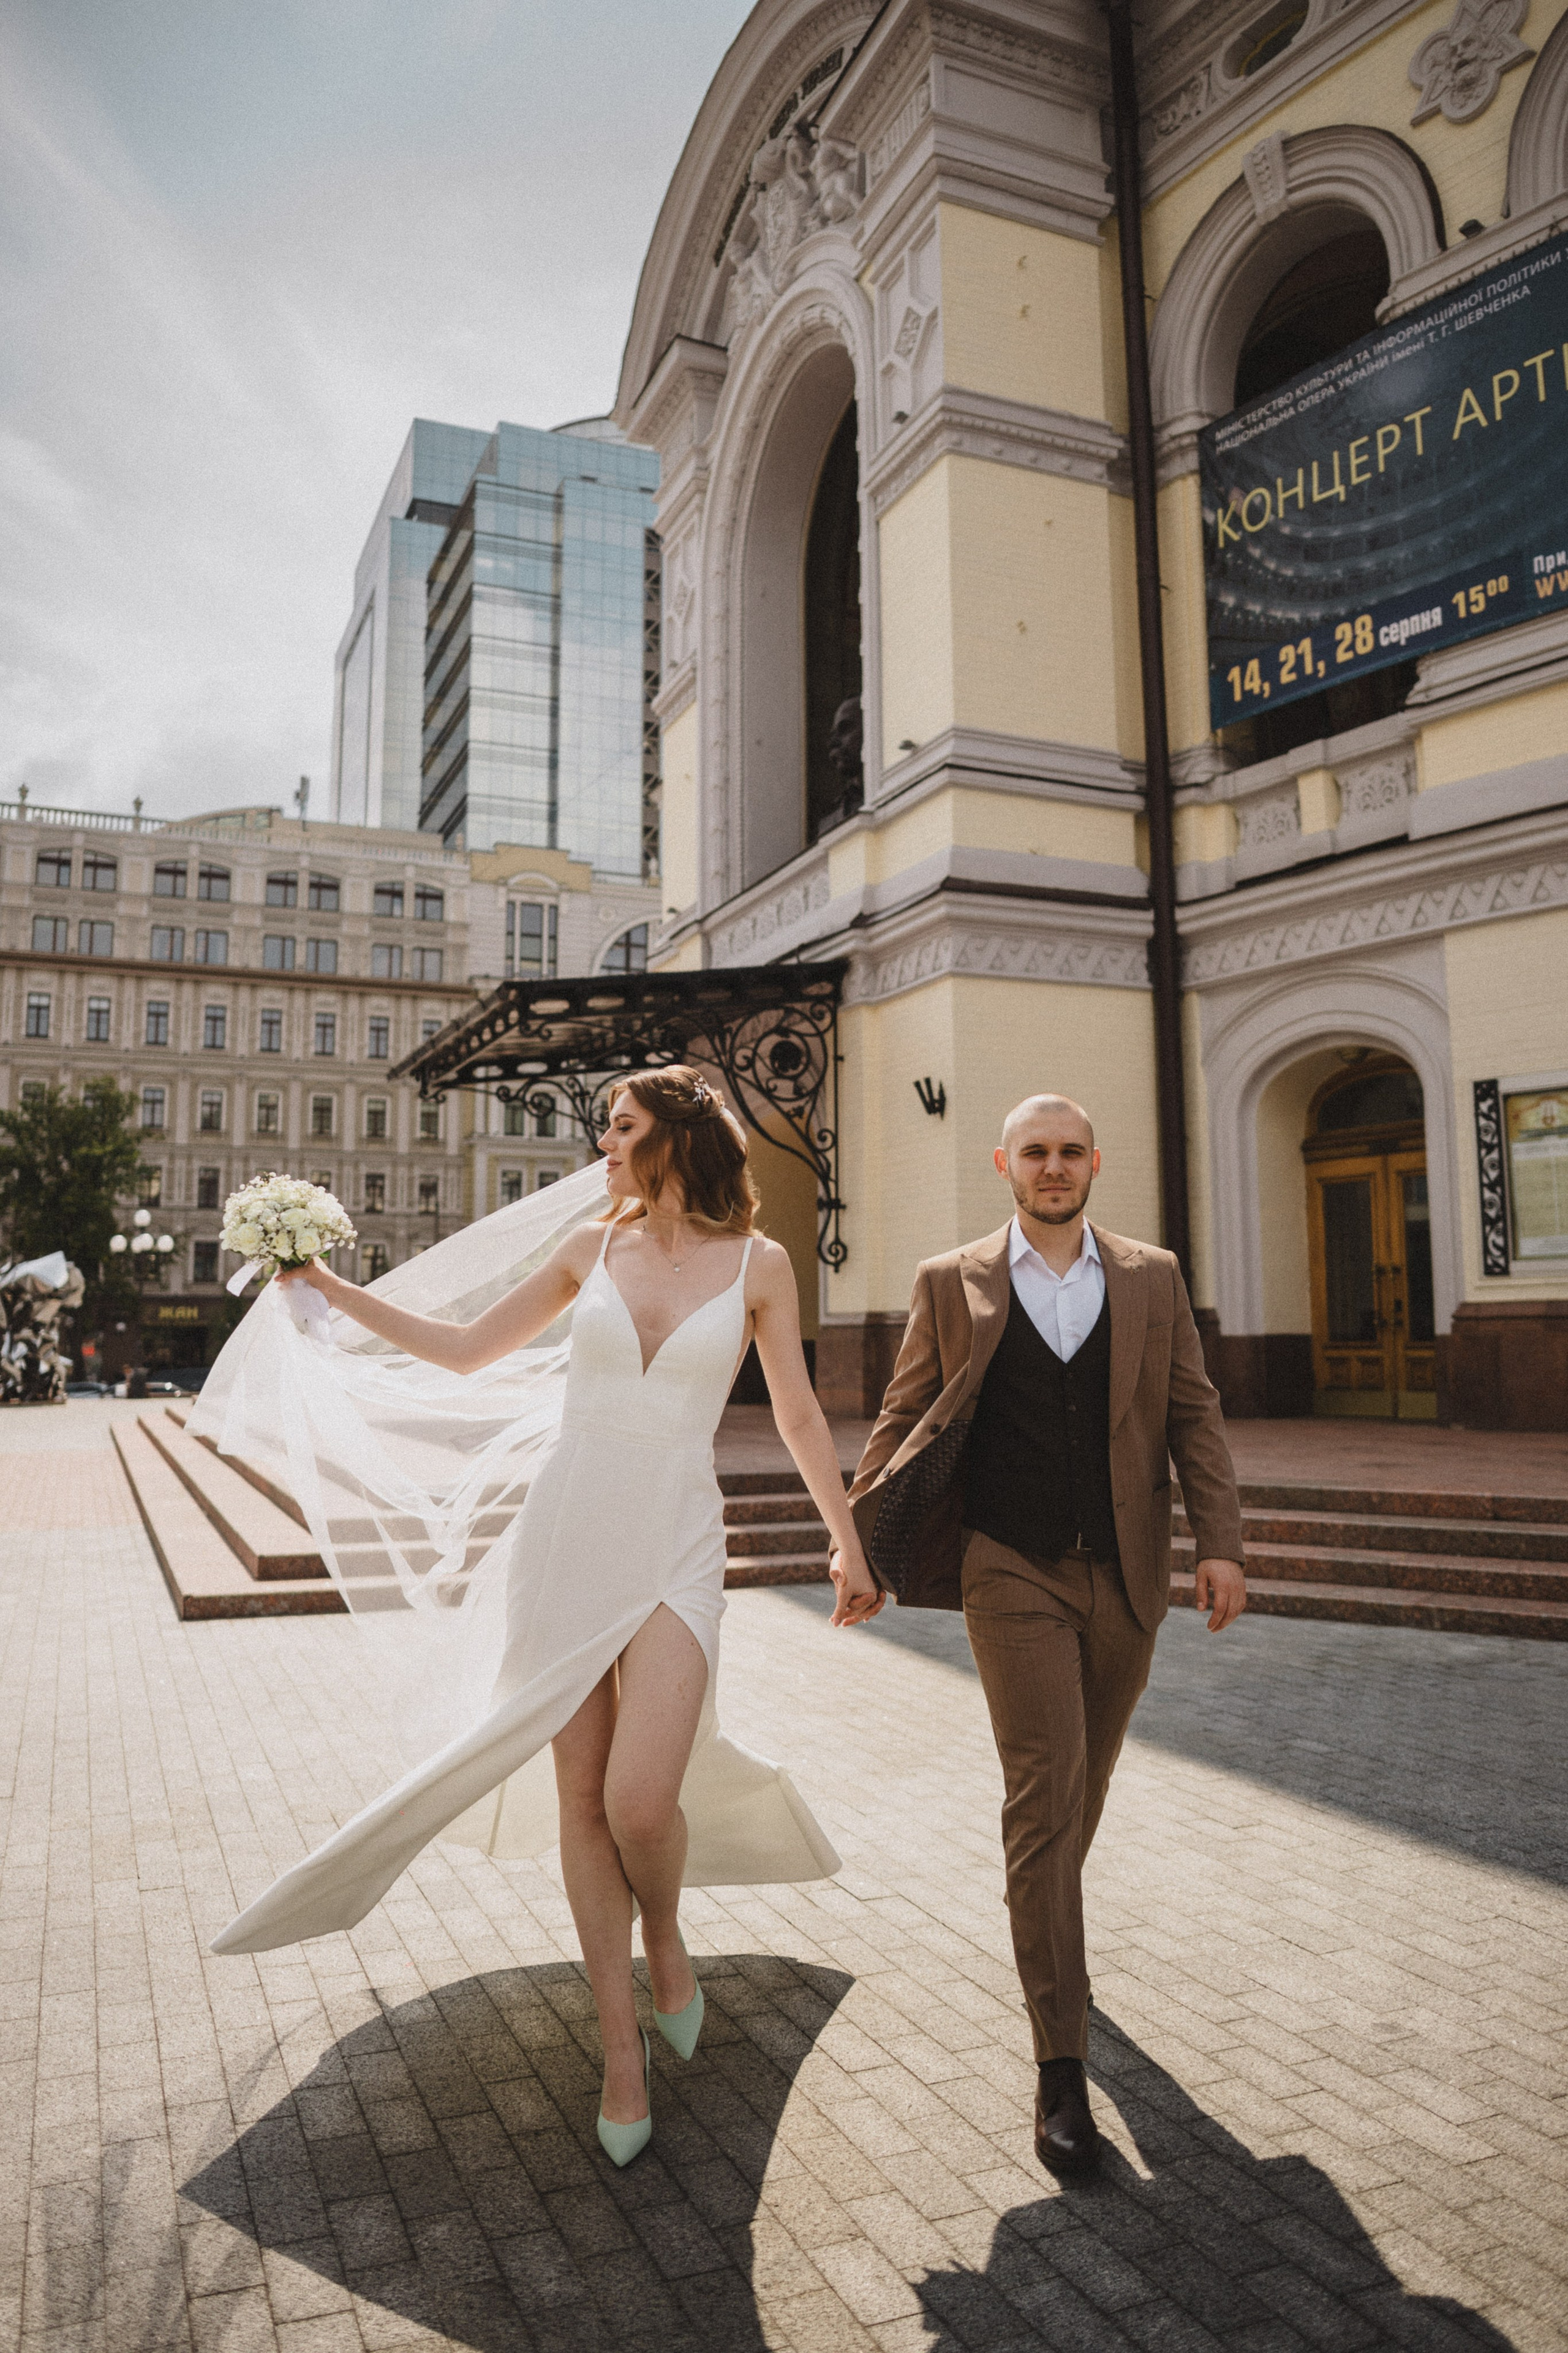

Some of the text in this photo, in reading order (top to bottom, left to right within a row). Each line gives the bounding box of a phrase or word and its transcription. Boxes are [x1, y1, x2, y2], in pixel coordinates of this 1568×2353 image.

[1215, 251, 1561, 441] МІНІСТЕРСТВО КУЛЬТУРИ ТА ІНФОРМАЦІЙНОЇ ПОЛІТИКИ
[1216, 406, 1295, 455] НАЦІОНАЛЬНА
[1298, 385, 1335, 412] ОПЕРА
[1337, 355, 1389, 391] УКРАЇНИ
[1427, 331, 1439, 343] Т.
[1441, 325, 1452, 338] Г.
[1455, 285, 1531, 331] ШЕВЧЕНКА
[1217, 342, 1568, 548] КОНЦЕРТ АРТ
[1227, 658, 1270, 703] 14,
[1279, 637, 1325, 685] 21,
[1335, 614, 1374, 663] 28
[1379, 606, 1442, 647] серпня
